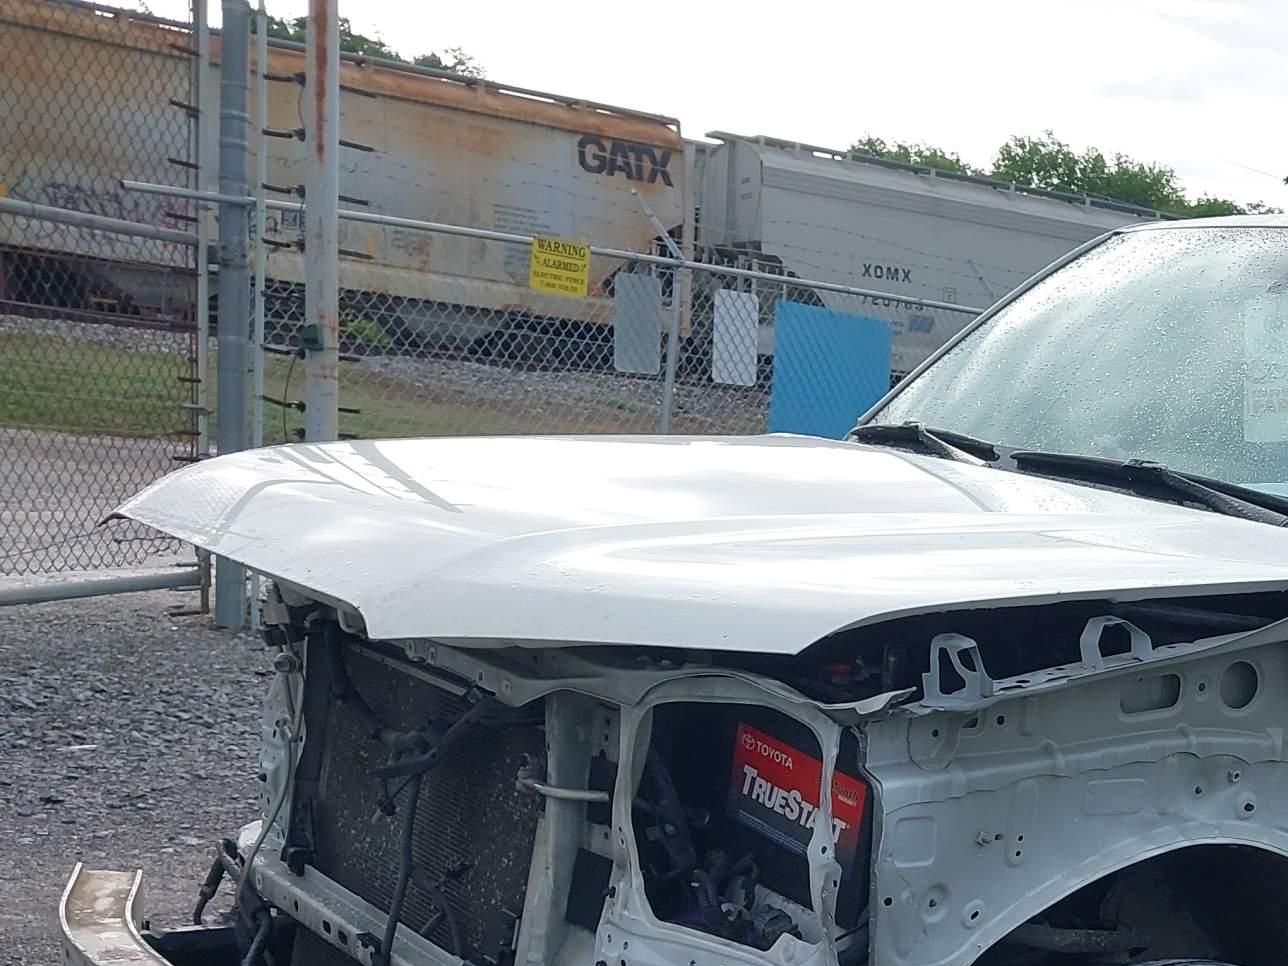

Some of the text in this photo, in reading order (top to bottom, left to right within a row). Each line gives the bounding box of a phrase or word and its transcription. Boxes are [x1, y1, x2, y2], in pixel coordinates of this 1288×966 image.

[577, 134, 674, 188] GATX
[537, 239, 586, 258] WARNING
[543, 258, 579, 272] ALARMED
[862, 263, 912, 283] XOMX
[756, 741, 793, 769] TOYOTA
